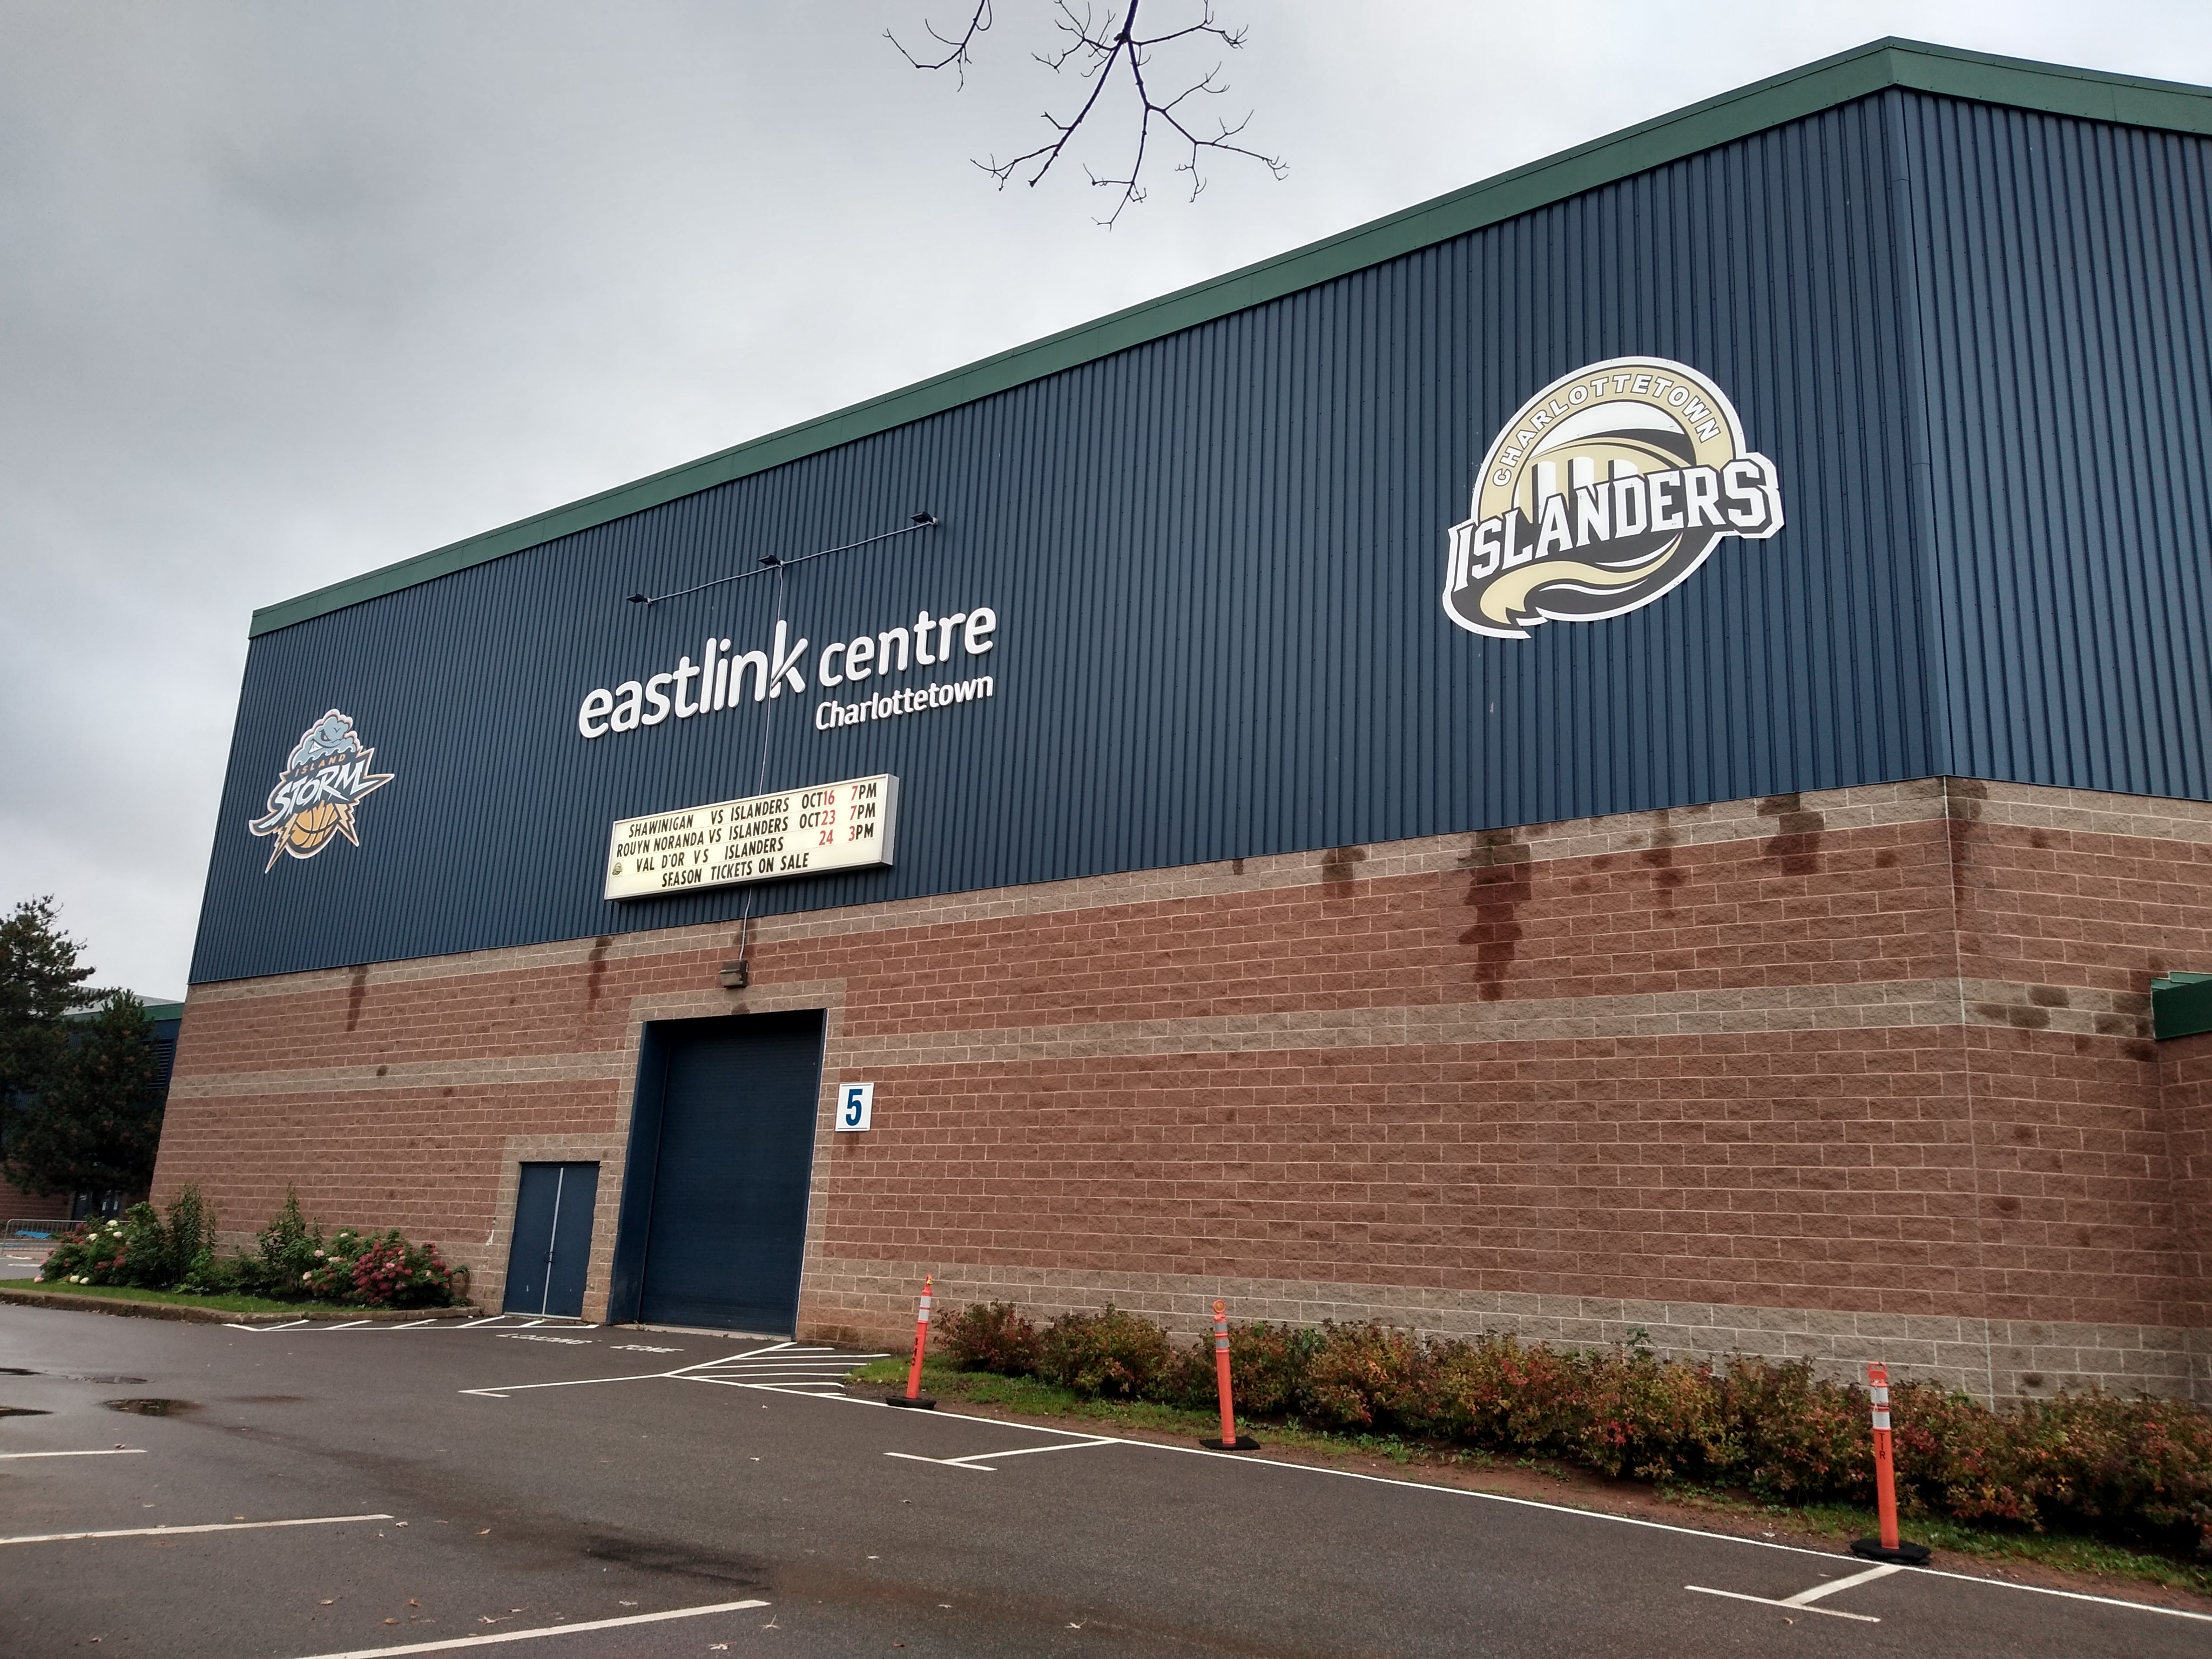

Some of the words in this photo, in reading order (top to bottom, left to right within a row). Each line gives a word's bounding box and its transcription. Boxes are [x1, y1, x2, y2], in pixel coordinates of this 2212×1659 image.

[1492, 374, 1721, 487] CHARLOTTETOWN
[1453, 461, 1766, 593] ISLANDERS
[578, 619, 808, 739] eastlink
[819, 607, 996, 687] centre
[815, 675, 994, 731] Charlottetown
[258, 759, 380, 828] STORM
[294, 754, 346, 777] ISLAND
[617, 839, 650, 858] ROUYN
[653, 831, 704, 852] NORANDA
[709, 828, 722, 844] VS
[729, 816, 788, 840] ISLANDERS
[849, 802, 876, 821] 7PM
[629, 814, 694, 838] SHAWINIGAN
[711, 809, 724, 825] VS
[731, 797, 790, 821] ISLANDERS
[851, 782, 877, 801] 7PM
[636, 857, 655, 873] VAL
[662, 852, 685, 868] D'OR
[725, 837, 784, 860] ISLANDERS
[819, 829, 834, 846] 24
[848, 822, 874, 841] 3PM
[662, 868, 702, 887] SEASON
[711, 860, 753, 880] TICKETS
[758, 857, 774, 873] ON
[780, 852, 810, 871] SALE
[846, 1088, 863, 1126] 5
